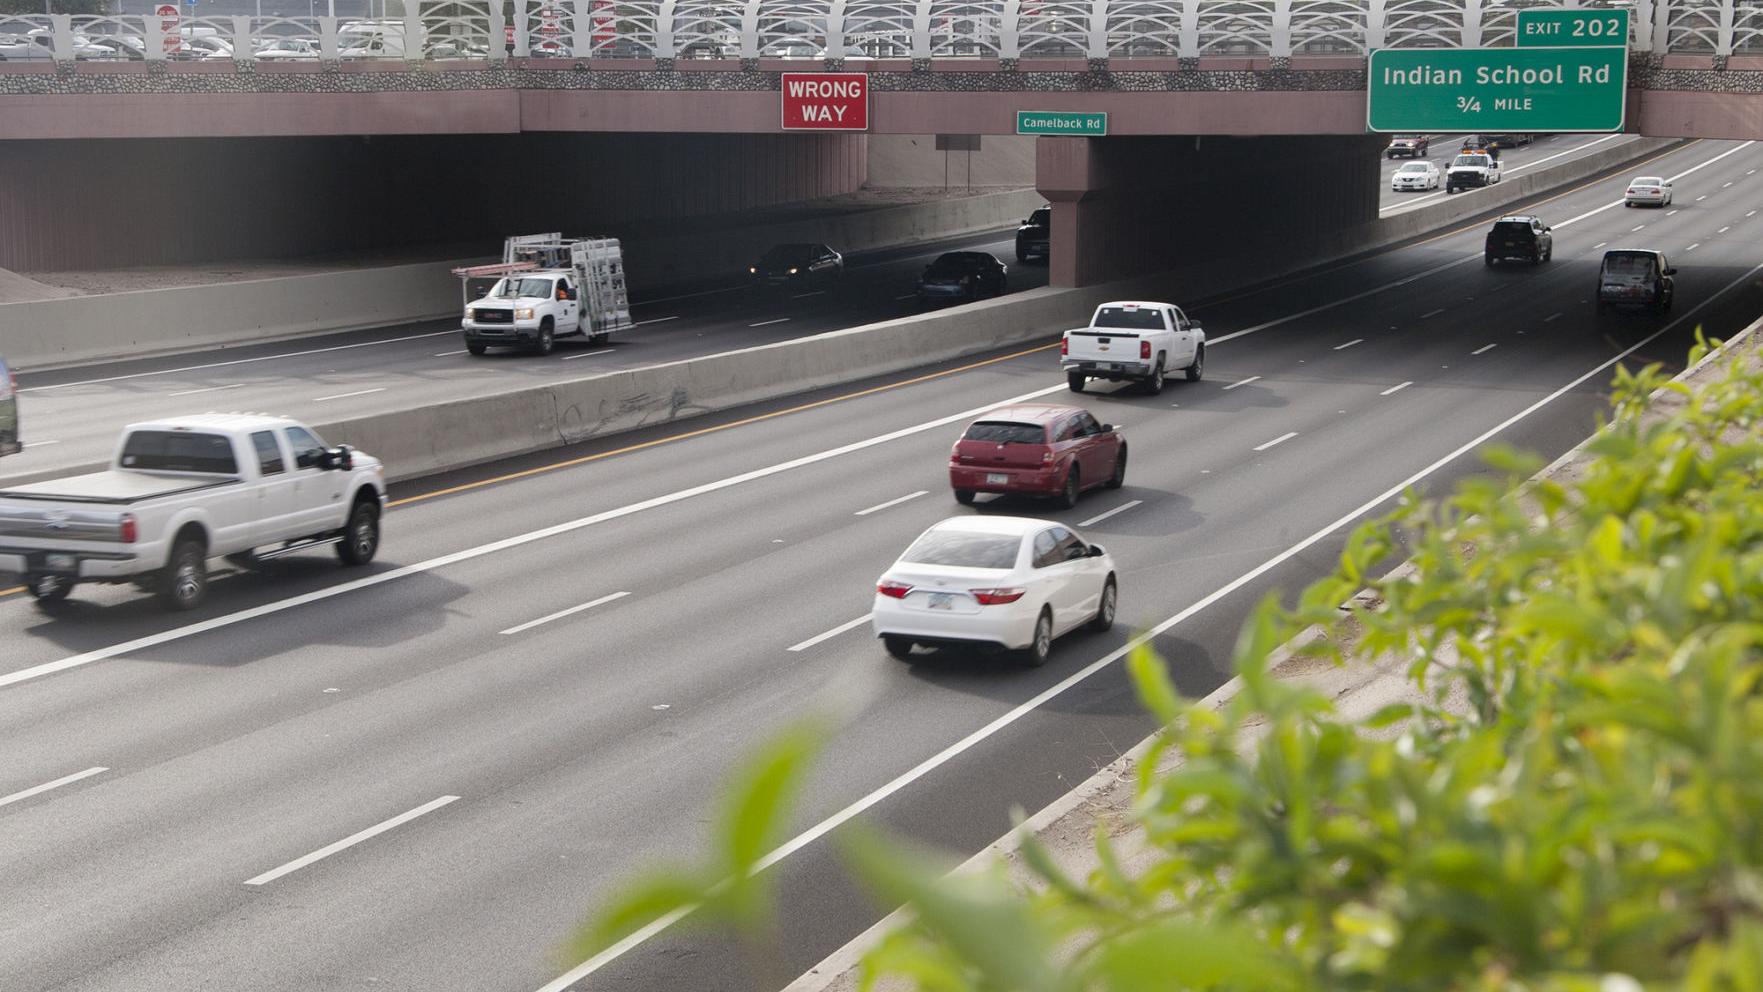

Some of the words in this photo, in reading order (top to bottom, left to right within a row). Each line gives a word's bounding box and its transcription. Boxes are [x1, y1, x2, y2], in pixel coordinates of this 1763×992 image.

[1526, 22, 1561, 34] EXIT
[1572, 19, 1619, 36] 202
[1383, 65, 1462, 85] Indian
[1476, 64, 1563, 84] School
[1578, 63, 1610, 84] Rd
[788, 81, 861, 98] WRONG
[1494, 98, 1532, 110] MILE
[801, 105, 848, 122] WAY
[1023, 117, 1082, 128] Camelback
[1087, 119, 1100, 129] Rd
